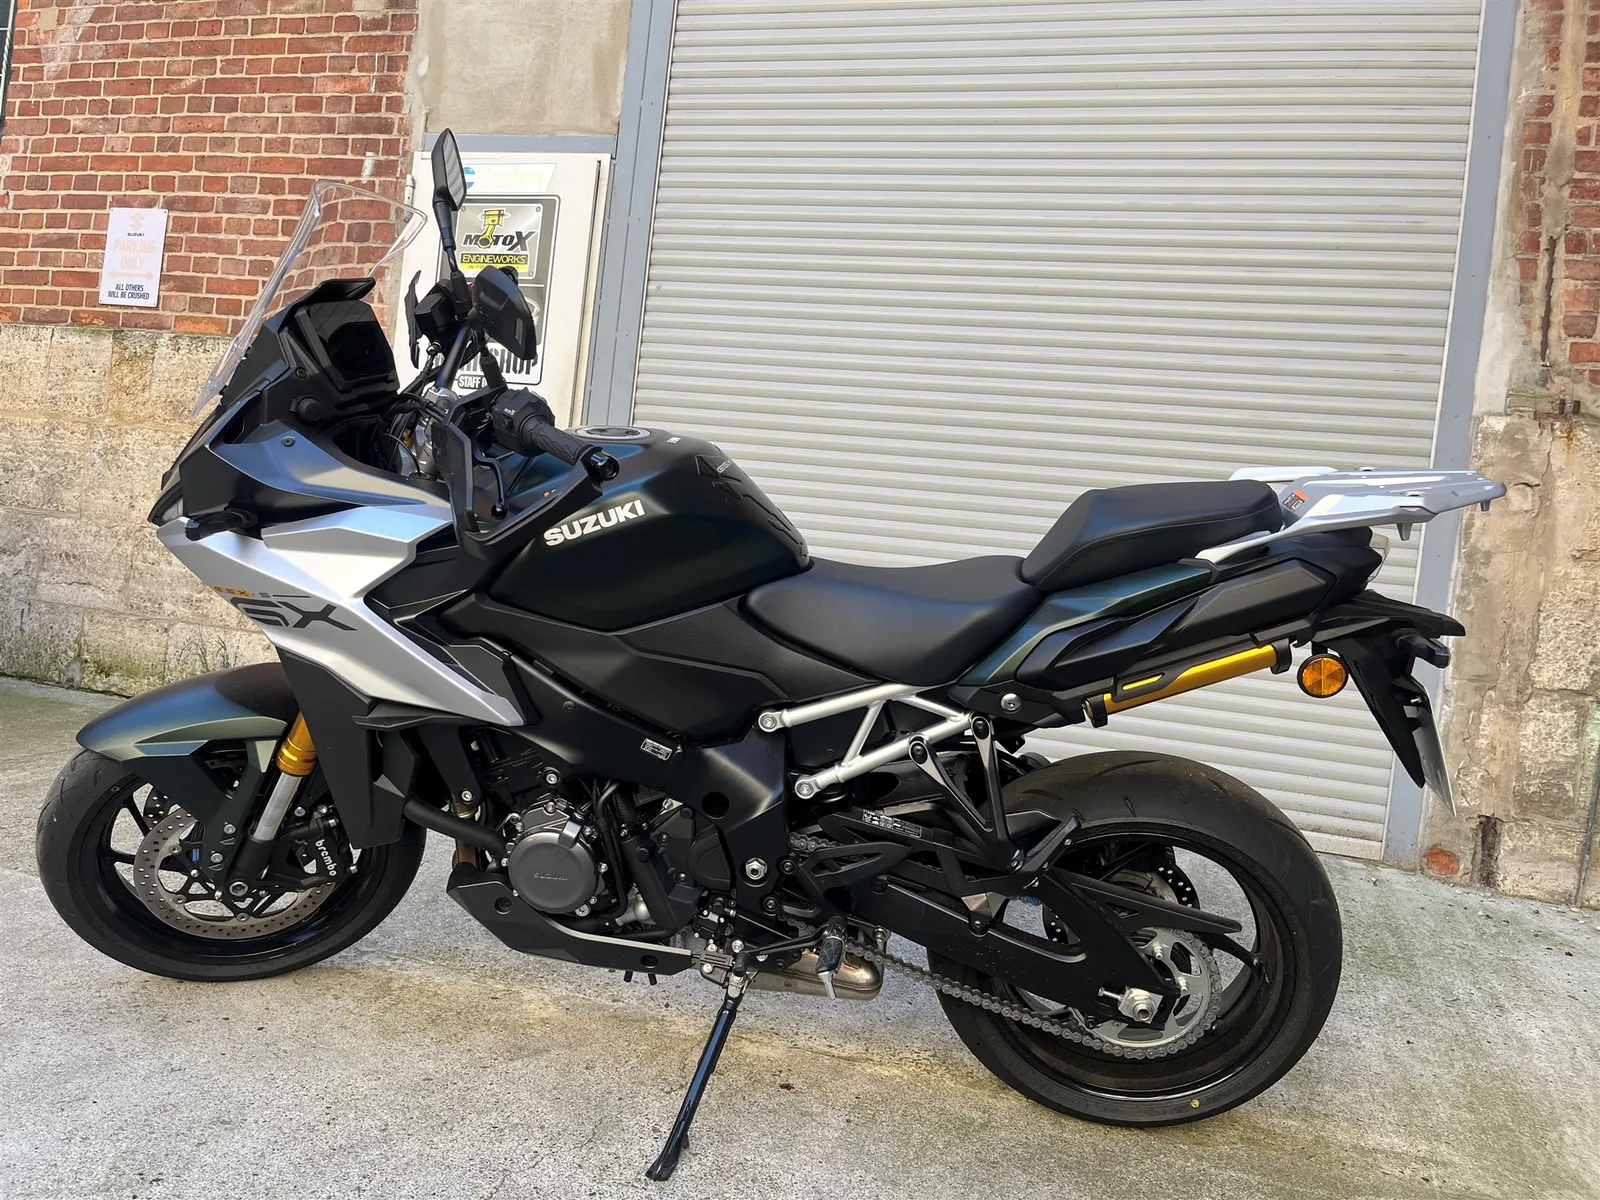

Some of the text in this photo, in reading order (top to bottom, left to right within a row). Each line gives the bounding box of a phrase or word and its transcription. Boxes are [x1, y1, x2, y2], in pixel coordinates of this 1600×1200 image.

[113, 238, 156, 254] PARKING
[121, 255, 145, 270] ONLY
[462, 254, 527, 264] ENGINEWORKS
[115, 283, 144, 292] ALL OTHERS
[120, 291, 127, 299] BE
[127, 292, 150, 300] CRUSHED
[459, 376, 481, 388] STAFF
[543, 499, 646, 547] SUZUKI
[315, 839, 337, 877] brembo
